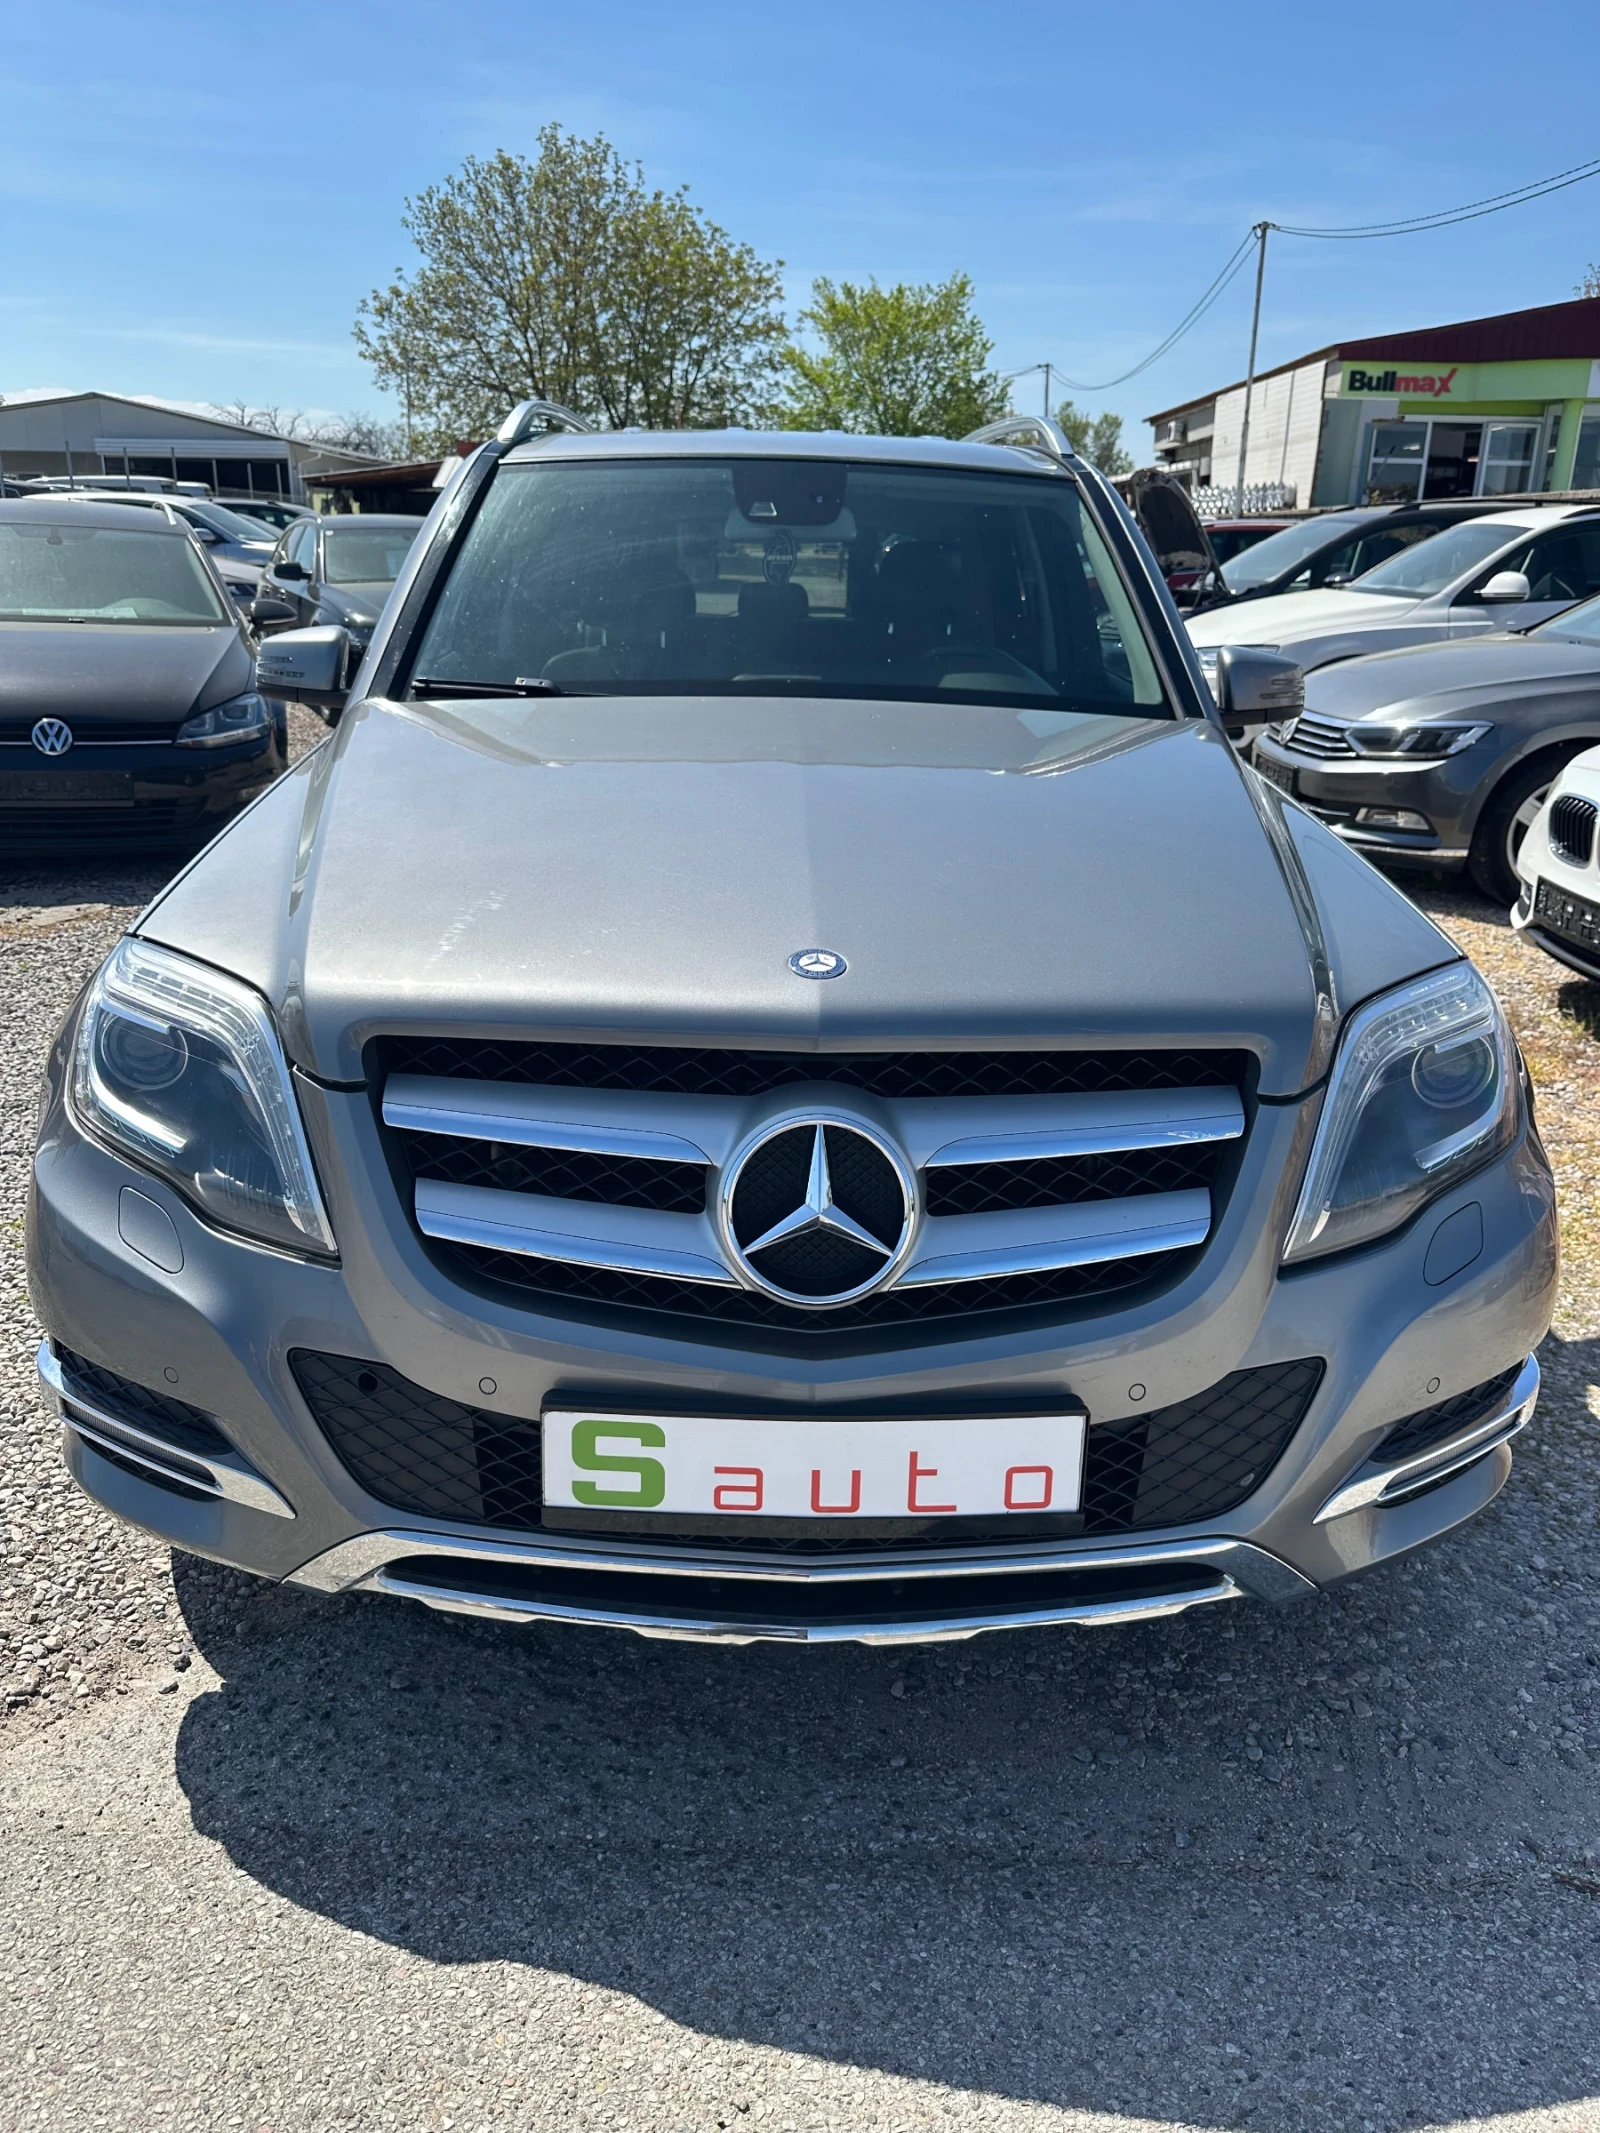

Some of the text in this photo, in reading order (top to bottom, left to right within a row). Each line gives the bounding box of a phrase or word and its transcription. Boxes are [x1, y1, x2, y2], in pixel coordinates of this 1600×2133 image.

[1348, 367, 1458, 398] Bullmax
[32, 718, 73, 755] VW
[572, 1420, 1053, 1513] S auto
